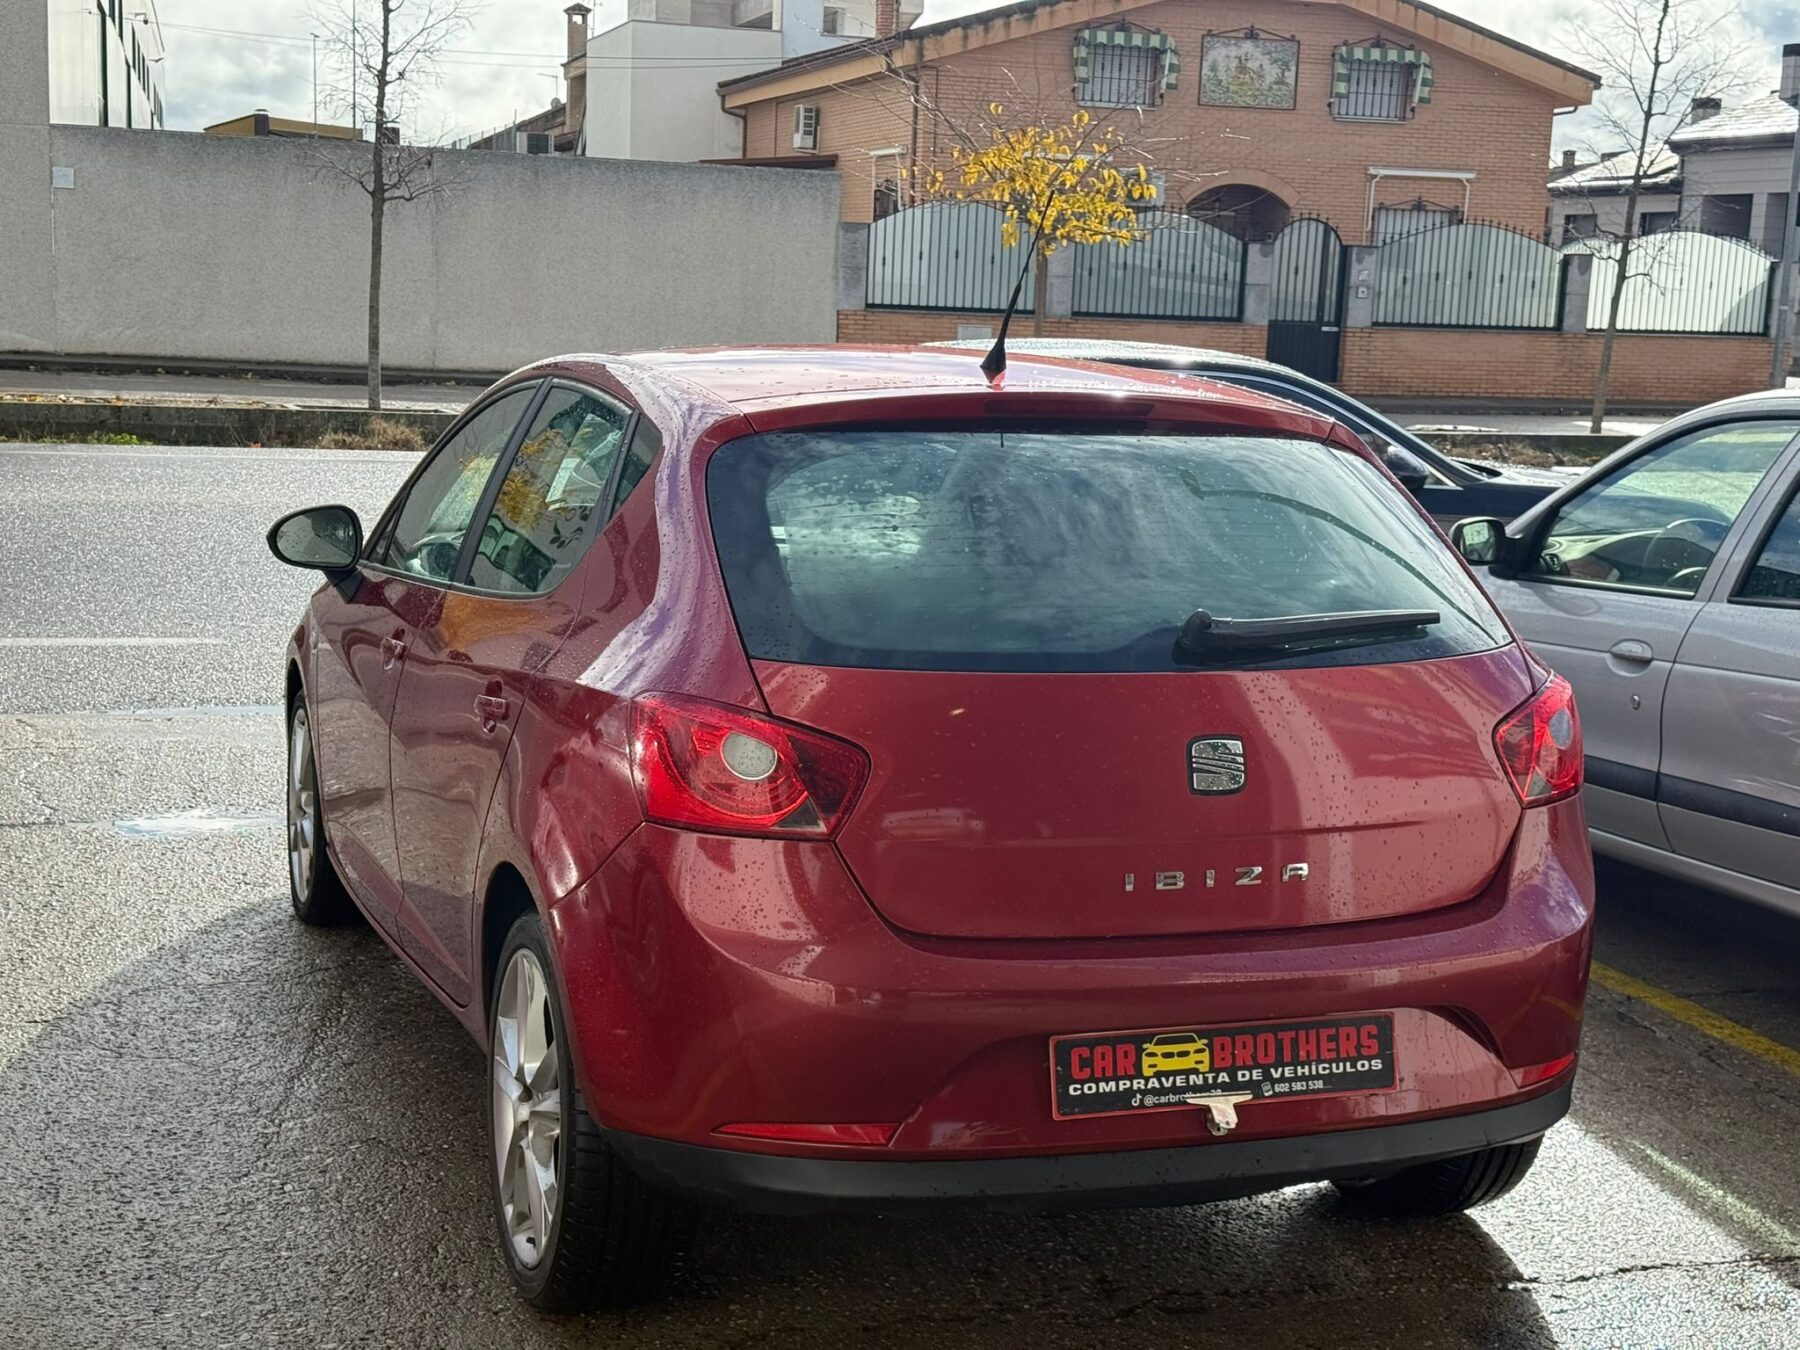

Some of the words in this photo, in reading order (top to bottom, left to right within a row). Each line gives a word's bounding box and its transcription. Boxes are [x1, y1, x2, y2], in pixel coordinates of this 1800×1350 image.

[1125, 863, 1309, 891] IBIZA
[1070, 1043, 1137, 1080] CAR
[1213, 1024, 1379, 1069] BROTHERS
[1068, 1072, 1230, 1096] COMPRAVENTA
[1237, 1069, 1263, 1082] DE
[1270, 1059, 1383, 1079] VEHÍCULOS
[1274, 1082, 1290, 1093] 602
